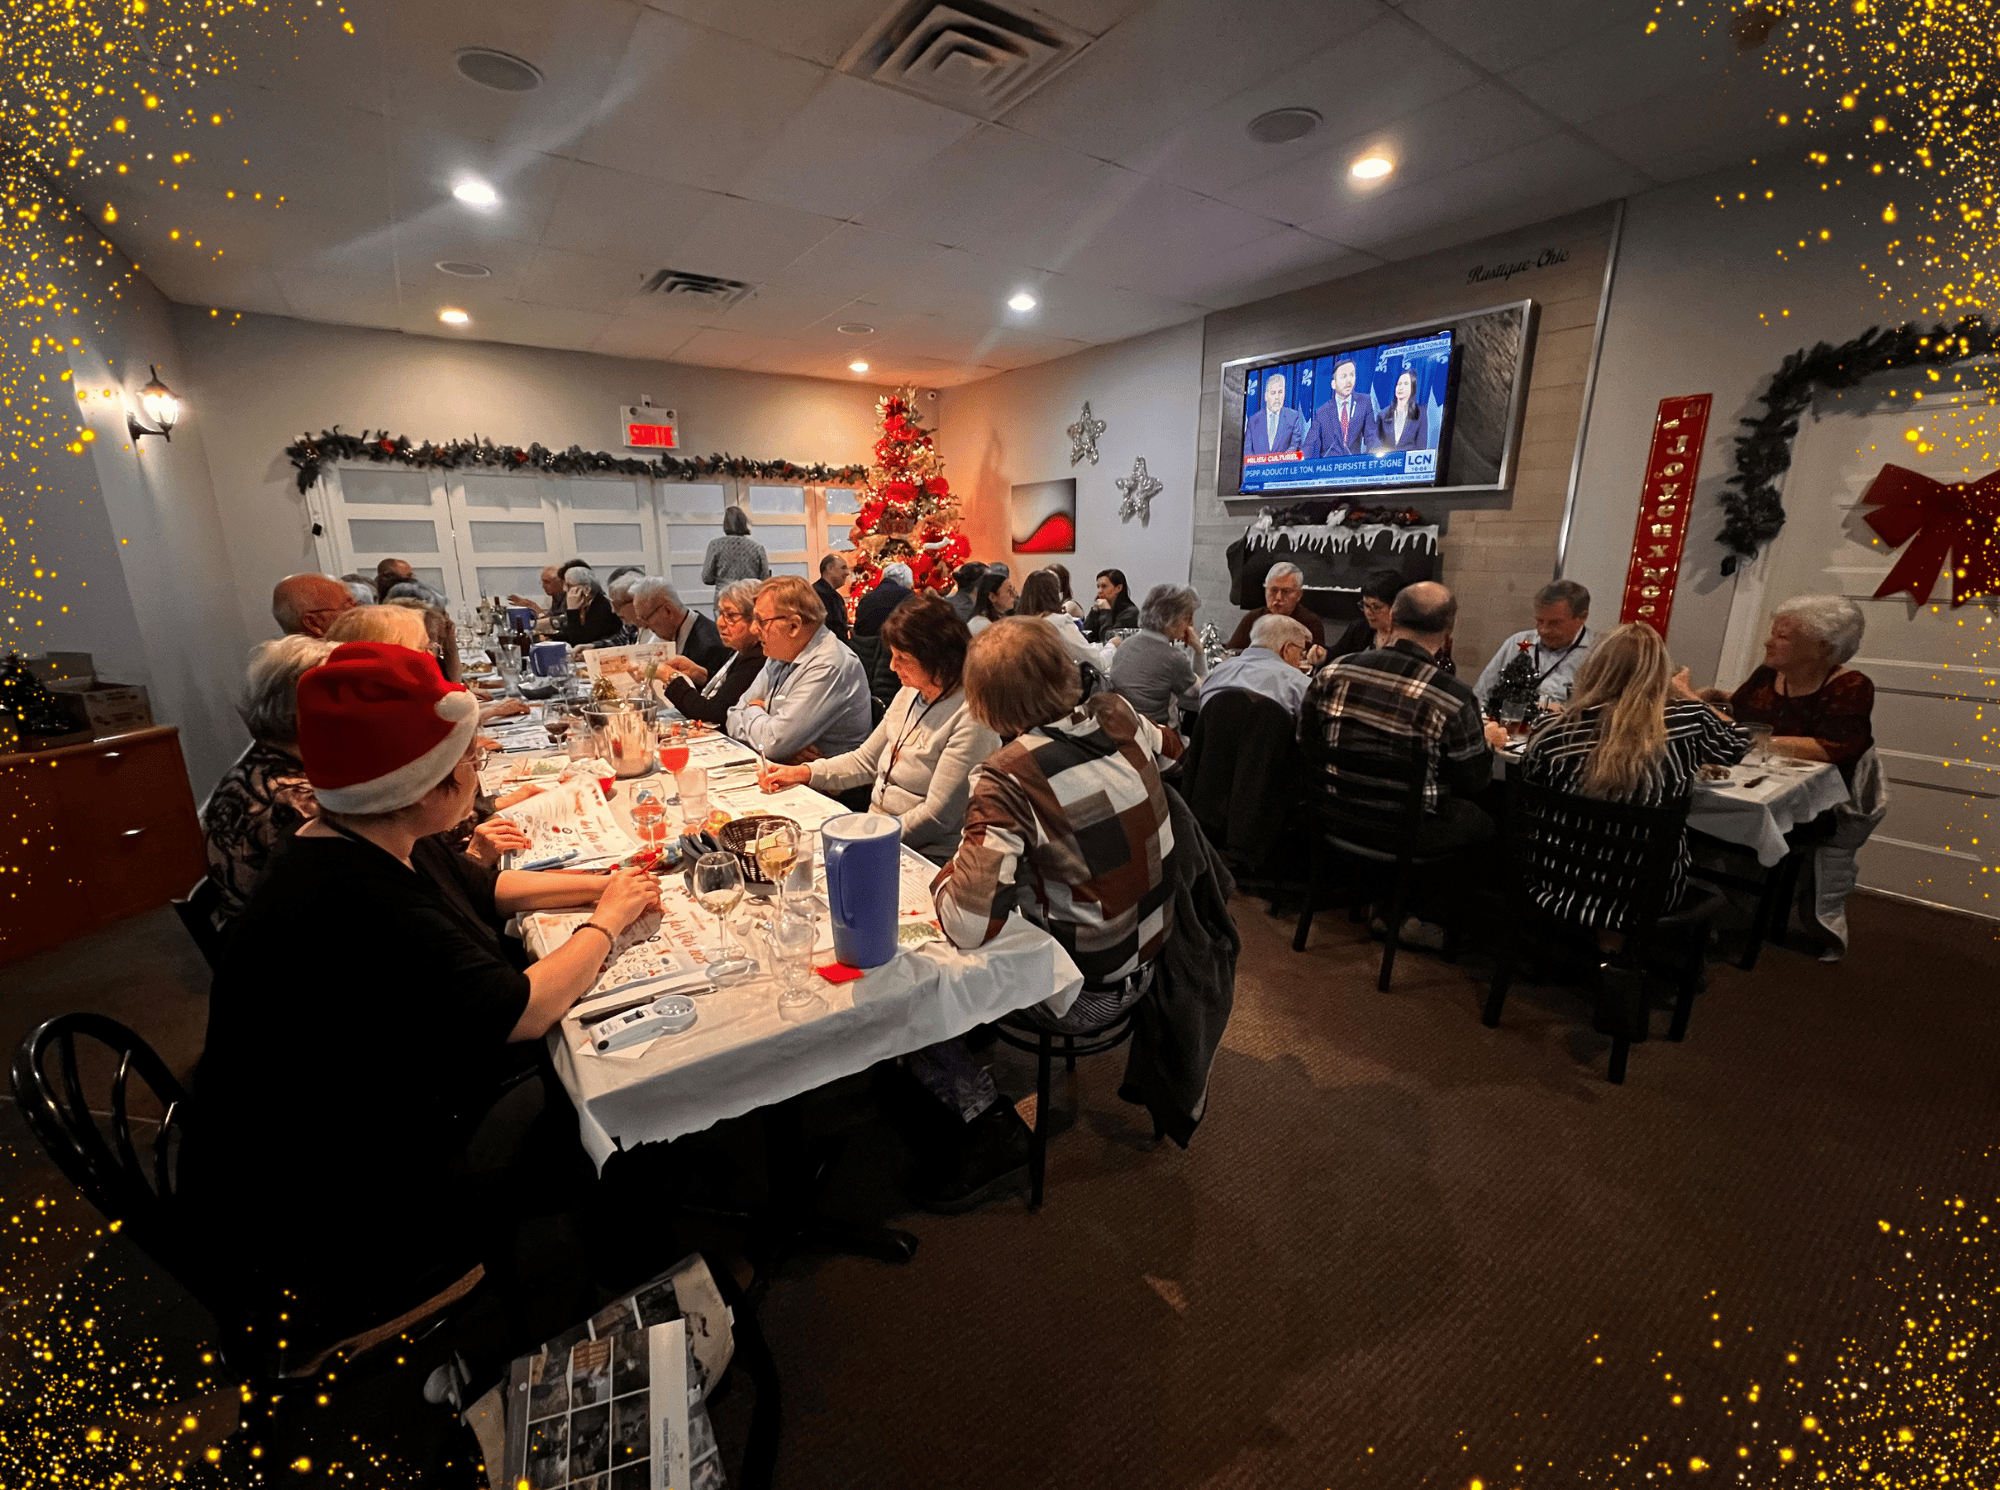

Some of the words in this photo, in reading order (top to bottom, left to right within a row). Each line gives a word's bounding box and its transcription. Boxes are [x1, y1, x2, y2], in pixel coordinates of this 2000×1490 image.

[629, 424, 675, 446] SORTIE
[1268, 453, 1299, 462] CULTUREL
[1408, 454, 1431, 465] LCN
[1246, 469, 1260, 477] PSPP
[1262, 467, 1288, 476] ADOUCIT
[1290, 466, 1297, 474] LE
[1300, 465, 1314, 473] TON,
[1316, 463, 1332, 472] MAIS
[1334, 461, 1366, 471] PERSISTE
[1369, 460, 1378, 469] ET
[1380, 458, 1403, 468] SIGNE
